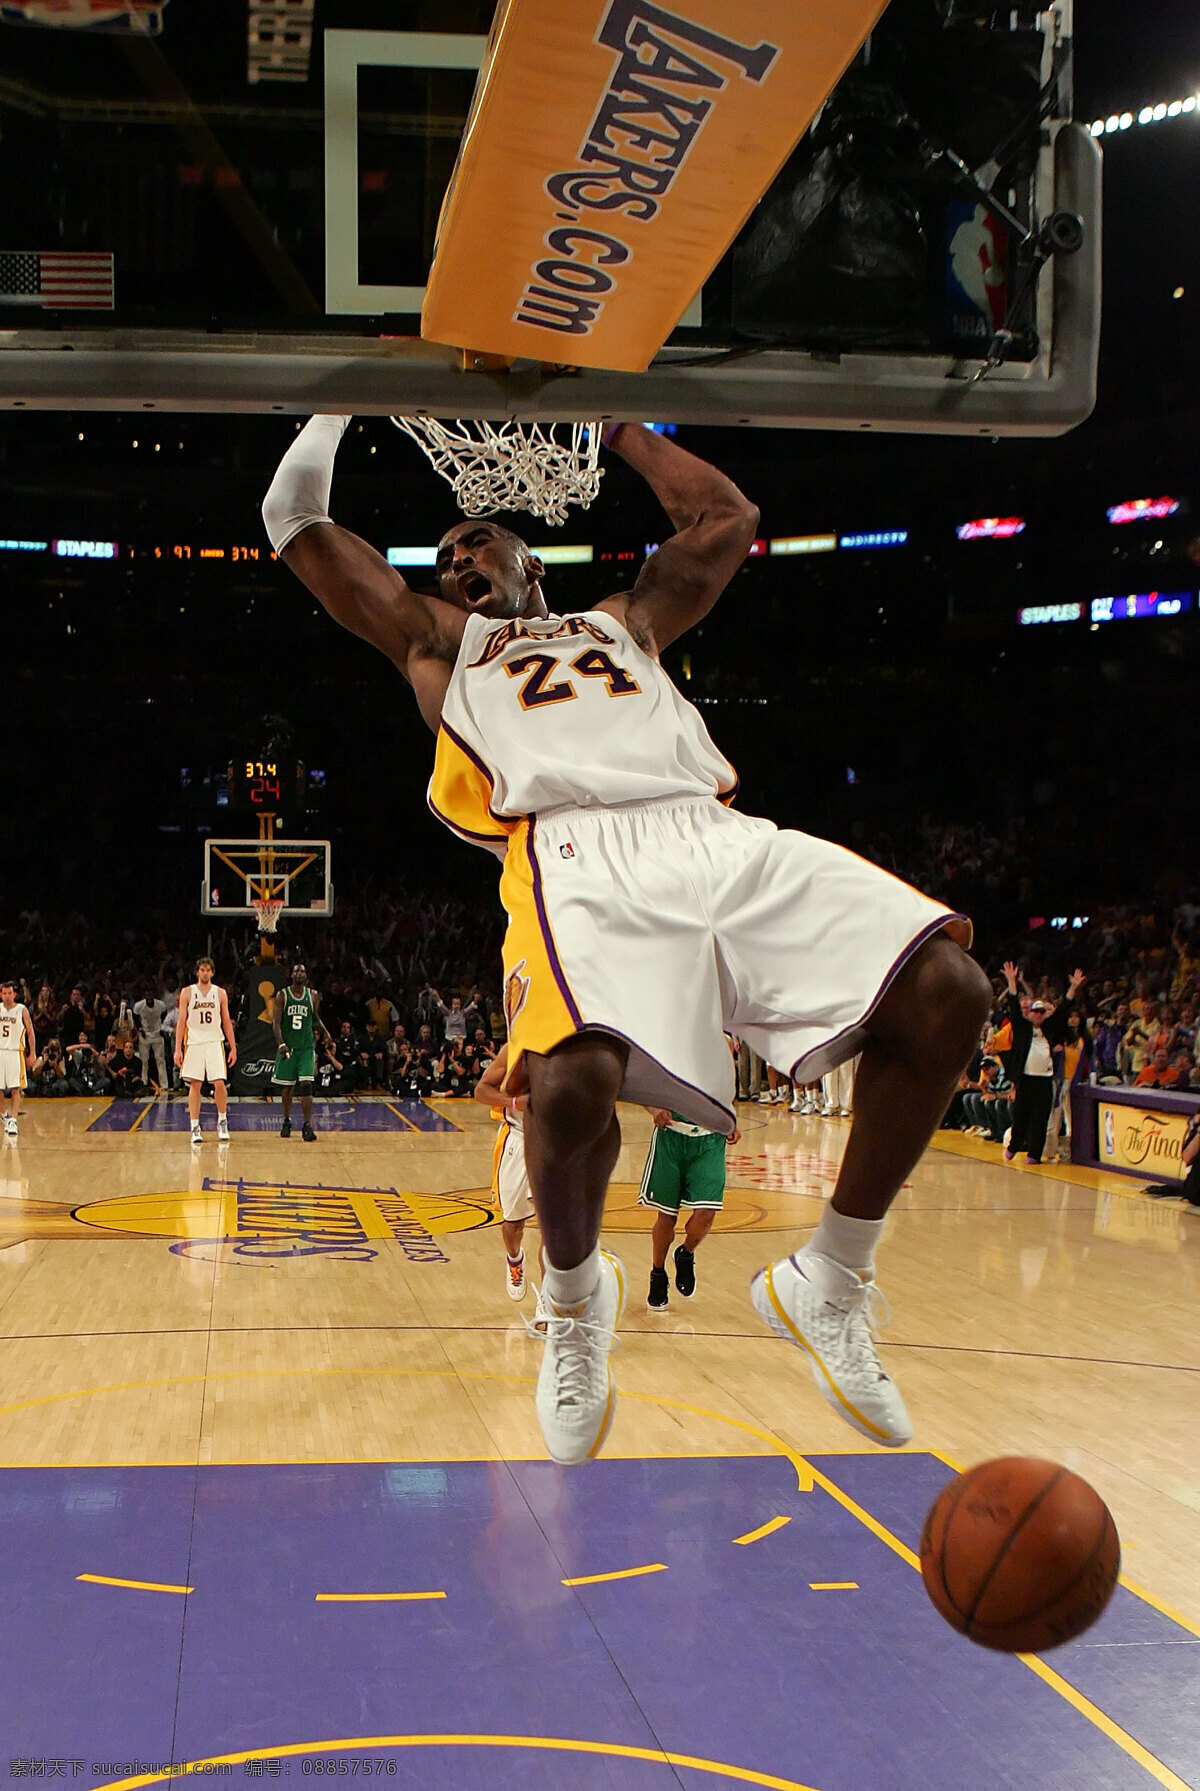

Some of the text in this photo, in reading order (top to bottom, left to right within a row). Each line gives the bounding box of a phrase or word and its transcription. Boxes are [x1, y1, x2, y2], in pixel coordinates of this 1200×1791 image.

[57, 539, 114, 558] STAPLES
[1020, 602, 1081, 625] STAPLES
[502, 648, 642, 711] 24
[245, 762, 277, 778] 37.4
[250, 778, 280, 803] 24
[199, 1011, 213, 1024] 16
[287, 1004, 309, 1017] CELTICS
[292, 1015, 303, 1030] 5
[1124, 1126, 1146, 1152] The
[168, 1177, 400, 1268] LAKERS
[373, 1198, 451, 1264] LOS ANGELES
